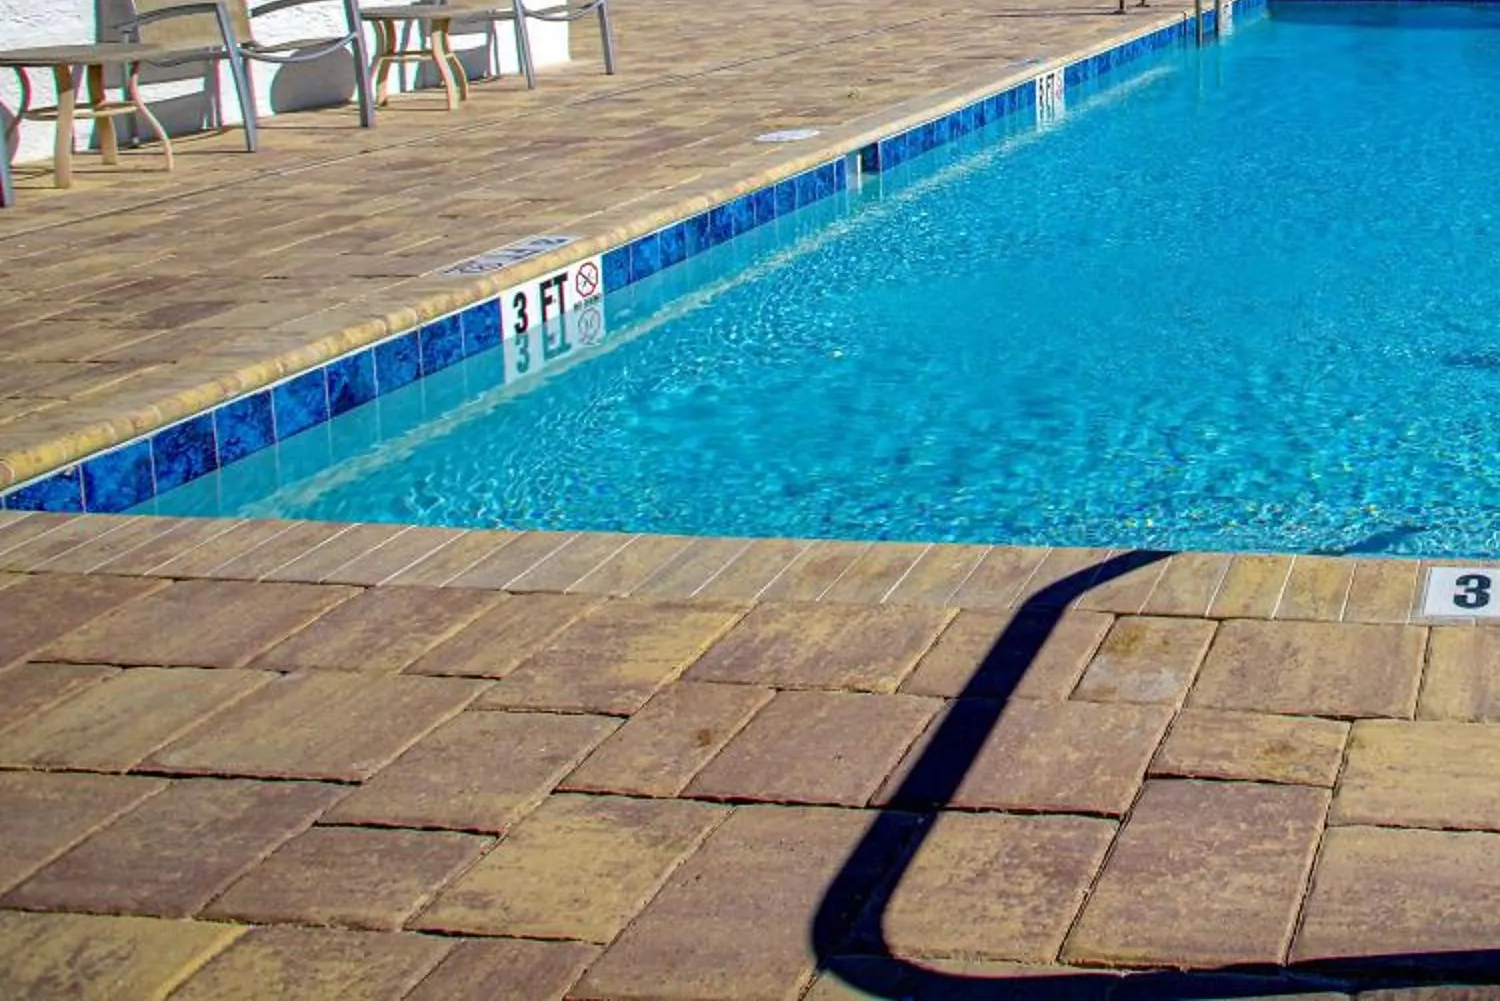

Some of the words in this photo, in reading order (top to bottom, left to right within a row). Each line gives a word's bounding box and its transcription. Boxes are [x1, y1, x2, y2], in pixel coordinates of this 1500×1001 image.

[513, 291, 529, 333] 3
[539, 272, 568, 324] FT
[1453, 574, 1492, 609] 3
